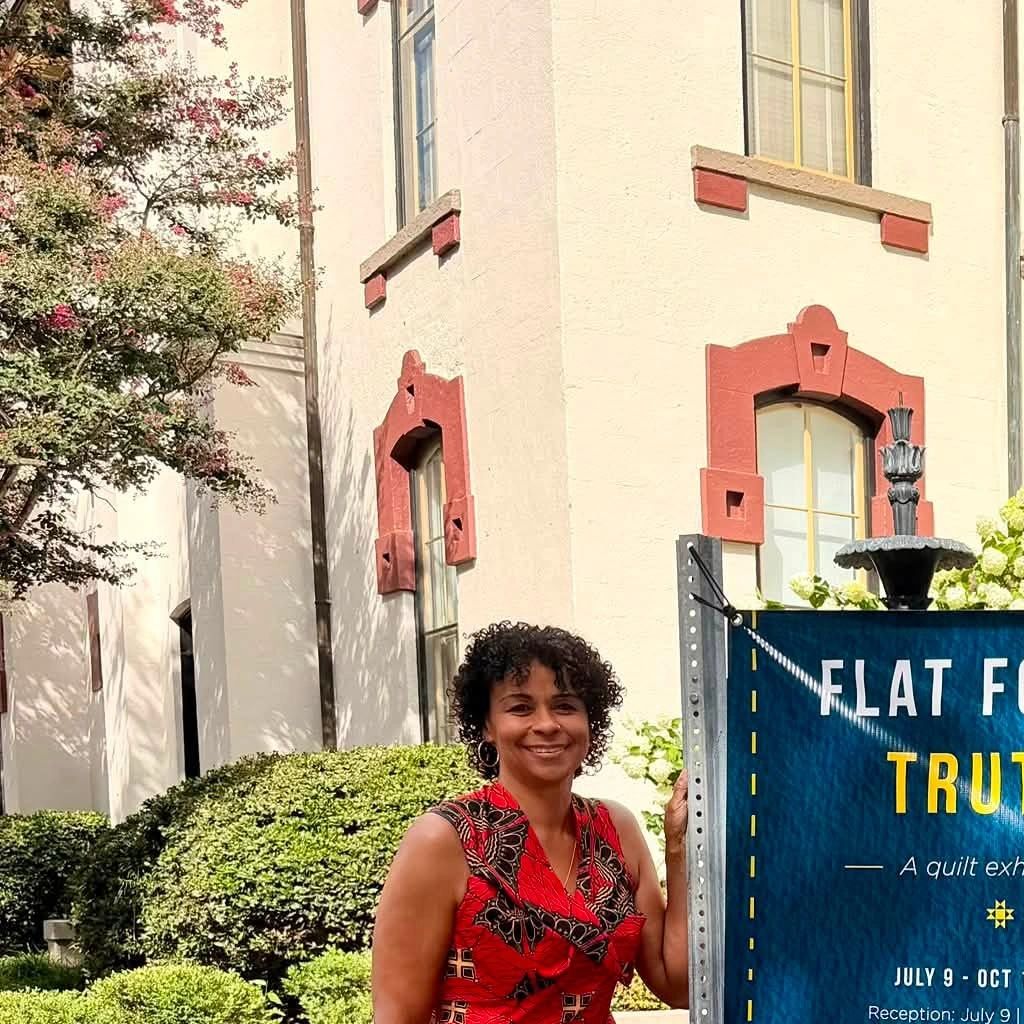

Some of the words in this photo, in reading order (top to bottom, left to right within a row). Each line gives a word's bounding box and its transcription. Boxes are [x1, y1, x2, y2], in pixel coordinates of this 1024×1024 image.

[819, 658, 953, 717] FLAT
[898, 858, 918, 877] A
[925, 855, 979, 880] quilt
[893, 966, 936, 987] JULY
[943, 967, 953, 988] 9
[977, 968, 1012, 989] OCT
[868, 1004, 956, 1023] Reception:
[1000, 1008, 1011, 1023] 9
